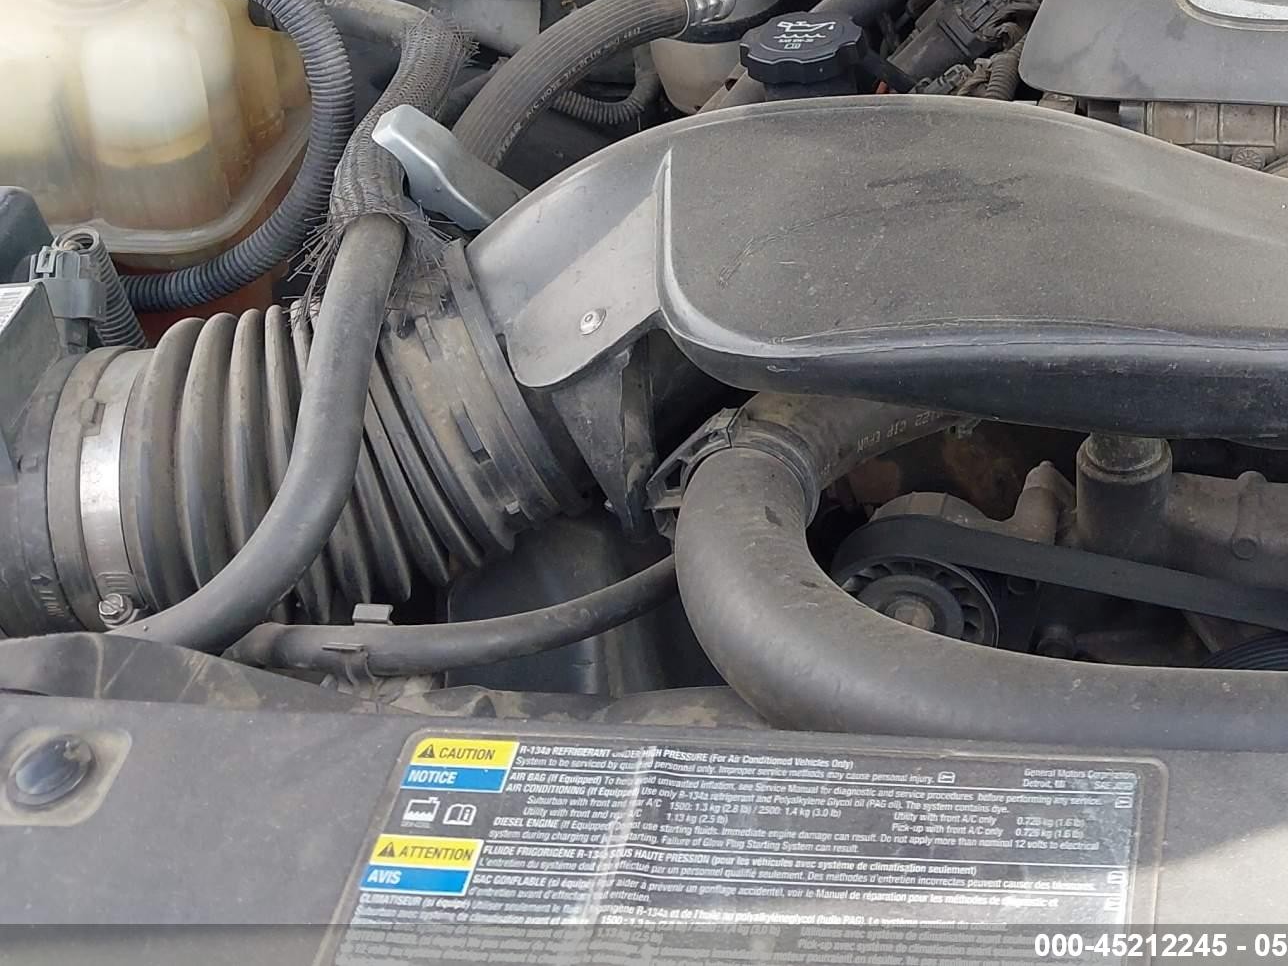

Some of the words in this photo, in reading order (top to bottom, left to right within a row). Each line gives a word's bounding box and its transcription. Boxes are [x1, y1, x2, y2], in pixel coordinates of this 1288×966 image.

[439, 747, 495, 760] CAUTION
[550, 746, 610, 757] REFRIGERANT
[662, 749, 707, 761] PRESSURE
[709, 752, 726, 764] (For
[726, 753, 740, 763] Air
[741, 754, 792, 766] Conditioned
[793, 757, 830, 767] Vehicles
[830, 759, 854, 770] Only)
[408, 771, 458, 784] NOTICE
[514, 756, 546, 768] System
[548, 758, 556, 767] to
[558, 758, 569, 767] be
[570, 758, 606, 768] serviced
[606, 760, 616, 770] by
[718, 766, 756, 777] Improper
[756, 767, 788, 777] service
[788, 768, 824, 779] methods
[826, 771, 842, 781] may
[844, 772, 870, 781] cause
[870, 772, 906, 784] personal
[908, 774, 934, 785] injury.
[505, 783, 522, 793] AIR
[522, 784, 584, 794] CONDITIONING
[641, 786, 657, 796] Use
[658, 787, 678, 799] only
[755, 794, 772, 804] and
[826, 797, 852, 809] Glycol
[853, 798, 864, 808] oil
[906, 801, 920, 811] The
[922, 802, 952, 813] system
[954, 803, 990, 813] contains
[990, 804, 1010, 815] dye.
[509, 772, 524, 781] AIR
[526, 772, 546, 782] BAG
[558, 773, 602, 785] Equipped)
[604, 775, 614, 784] To
[754, 782, 786, 793] Service
[788, 784, 818, 794] Manual
[820, 785, 832, 794] for
[832, 786, 875, 798] diagnostic
[876, 788, 893, 797] and
[894, 788, 924, 799] service
[978, 793, 1006, 803] before
[1005, 794, 1052, 806] performing
[522, 806, 547, 818] Utility
[548, 808, 568, 817] with
[570, 808, 590, 818] front
[590, 809, 608, 819] and
[686, 814, 698, 824] kg
[698, 814, 716, 825] (2.5
[526, 795, 568, 806] Suburban
[568, 797, 588, 806] with
[590, 798, 610, 807] front
[709, 803, 720, 814] kg
[784, 806, 798, 816] 1.4
[799, 807, 810, 818] kg
[812, 808, 828, 819] (3.0
[830, 809, 842, 820] lb)
[894, 811, 918, 822] Utility
[918, 812, 938, 822] with
[940, 813, 960, 822] front
[961, 814, 978, 823] A/C
[978, 814, 996, 826] only
[492, 817, 524, 827] DIESEL
[525, 818, 560, 828] ENGINE
[642, 823, 658, 832] use
[658, 823, 692, 835] starting
[720, 826, 766, 838] Immediate
[767, 829, 796, 840] engine
[798, 830, 832, 841] damage
[832, 832, 850, 841] can
[850, 832, 876, 842] result.
[880, 833, 890, 842] Do
[892, 834, 908, 844] not
[908, 835, 932, 846] apply
[934, 837, 956, 846] more
[958, 837, 977, 846] than
[1014, 839, 1026, 848] 12
[1026, 840, 1048, 849] volts
[890, 822, 924, 834] Pick-up
[924, 824, 944, 833] with
[946, 824, 966, 834] front
[967, 825, 984, 835] A/C
[984, 826, 1004, 837] only
[521, 830, 548, 842] during
[550, 831, 588, 843] charging
[660, 835, 690, 845] Failure
[692, 836, 702, 846] of
[724, 838, 746, 850] Plug
[746, 839, 782, 851] Starting
[782, 841, 814, 852] System
[814, 843, 832, 852] can
[400, 846, 474, 861] ATTENTION
[634, 849, 664, 860] HAUTE
[664, 851, 710, 863] PRESSION
[856, 862, 868, 871] de
[869, 862, 926, 874] climatisation
[928, 865, 977, 877] seulement)
[367, 869, 402, 884] AVIS
